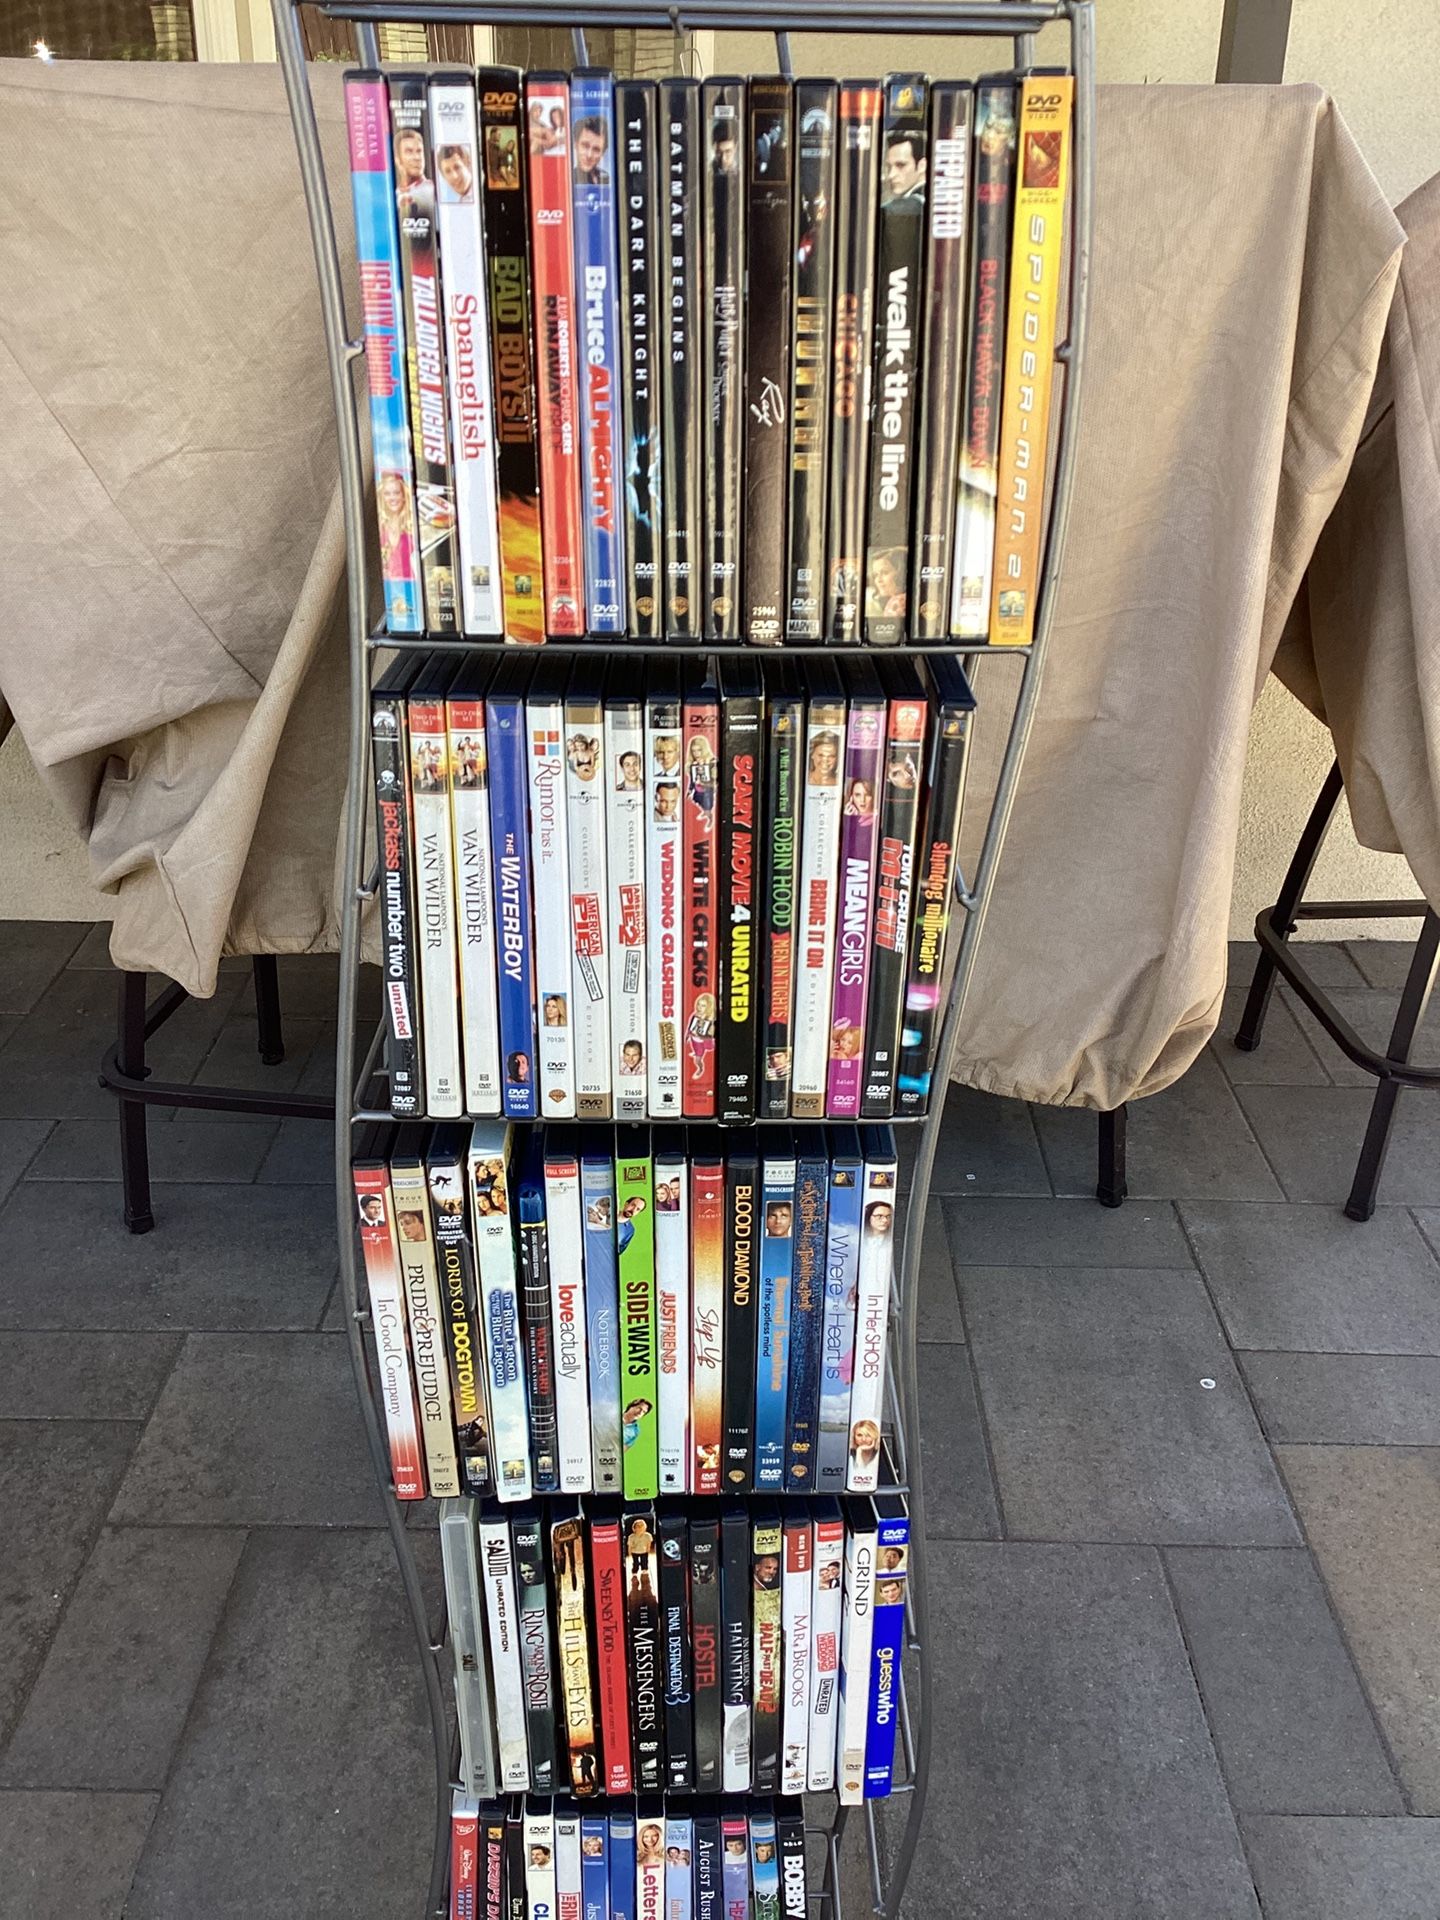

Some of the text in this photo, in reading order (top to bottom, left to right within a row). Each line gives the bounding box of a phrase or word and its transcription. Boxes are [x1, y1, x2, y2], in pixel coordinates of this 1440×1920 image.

[352, 95, 365, 159] EDITION
[366, 97, 379, 156] SPECIAL
[483, 91, 517, 106] DVD
[1027, 95, 1062, 108] DVD
[932, 139, 965, 239] DEPARTED
[629, 118, 648, 399] THE DARK KNIGHT
[670, 122, 684, 363] BATMAN BEGINS
[411, 274, 443, 388] TALLADEGA
[495, 256, 532, 441] BAD BOYS II
[545, 294, 560, 402] RUNAWAY
[968, 259, 998, 469] BLACK HAWK DOWN
[450, 293, 486, 461] Spanglish
[558, 319, 573, 456] ROBERTS GERE
[585, 265, 615, 535] Bruce ALMIGHTY
[750, 376, 786, 427] Ray
[879, 266, 911, 511] walk the line
[1006, 214, 1046, 578] SPIDER-MAN 2
[420, 386, 446, 466] NIGHTS
[592, 604, 619, 614] DVD
[750, 620, 780, 631] DVD
[534, 759, 561, 848] Rumor has
[380, 800, 406, 978] jackass number two
[423, 832, 442, 950] VAN WILDER
[438, 852, 449, 930] NATIONAL LAMPOON'S
[462, 828, 483, 946] VAN WILDER
[478, 847, 489, 926] NATIONAL LAMPOON'S
[501, 832, 523, 983] THE WATERBOY
[730, 754, 753, 1023] SCARY MOVIE 4 UNRATED
[772, 816, 793, 927] ROBIN HOOD
[895, 843, 914, 953] TOM CRUISE
[917, 841, 951, 973] slumdog millionaire
[574, 896, 591, 952] PIE
[587, 897, 603, 954] AMERICAN
[619, 887, 640, 945] PIE 2
[661, 840, 675, 1018] WEDDING CRASHERS
[806, 879, 828, 968] BRING IT ON
[839, 858, 869, 985] MEAN GIRLS
[391, 984, 410, 1036] unrated
[771, 940, 790, 1019] MEN IN TIGHTS
[664, 1023, 676, 1058] UNCORKED
[733, 1185, 752, 1306] BLOOD DIAMOND
[407, 1264, 442, 1422] PRIDE & PREJUDICE
[444, 1249, 478, 1412] LORDS OF DOGTOWN
[492, 1316, 504, 1343] Blue
[503, 1294, 518, 1380] The Blue Lagoon
[558, 1284, 577, 1323] love
[598, 1308, 610, 1379] NOTEBOOK
[626, 1281, 651, 1376] SIDEWAYS
[660, 1290, 677, 1374] JUST FRIENDS
[695, 1306, 721, 1369] Step Up
[762, 1277, 773, 1357] of the spotless mind
[826, 1234, 849, 1379] Where the Heart Is
[862, 1294, 883, 1379] In Her SHOES
[378, 1299, 403, 1418] In Good Company
[492, 1344, 507, 1388] Lagoon
[495, 1578, 510, 1653] UNRATED EDITION
[521, 1608, 547, 1645] RING
[599, 1567, 615, 1623] SWEENEY
[562, 1601, 589, 1728] THE HILLS HAVE EYES
[603, 1622, 617, 1653] TODD
[633, 1605, 656, 1731] THE MESSENGERS
[665, 1606, 691, 1706] FINAL DESTINATION 3
[694, 1623, 716, 1692] HOSTEL
[729, 1622, 743, 1703] HAUNTING
[742, 1637, 750, 1686] AN AMERICAN
[757, 1622, 776, 1713] HALF PAST DEAD 2
[819, 1635, 829, 1671] WEDDING
[826, 1634, 836, 1670] AMERICAN
[526, 1672, 550, 1709] ROSIE
[791, 1650, 808, 1707] BROOKS
[818, 1680, 832, 1713] UNRATED
[876, 1647, 895, 1724] guess who
[486, 1842, 501, 1903] DARRIN'S
[699, 1839, 717, 1920] AUGUST RUSH
[784, 1854, 806, 1919] BOBBY
